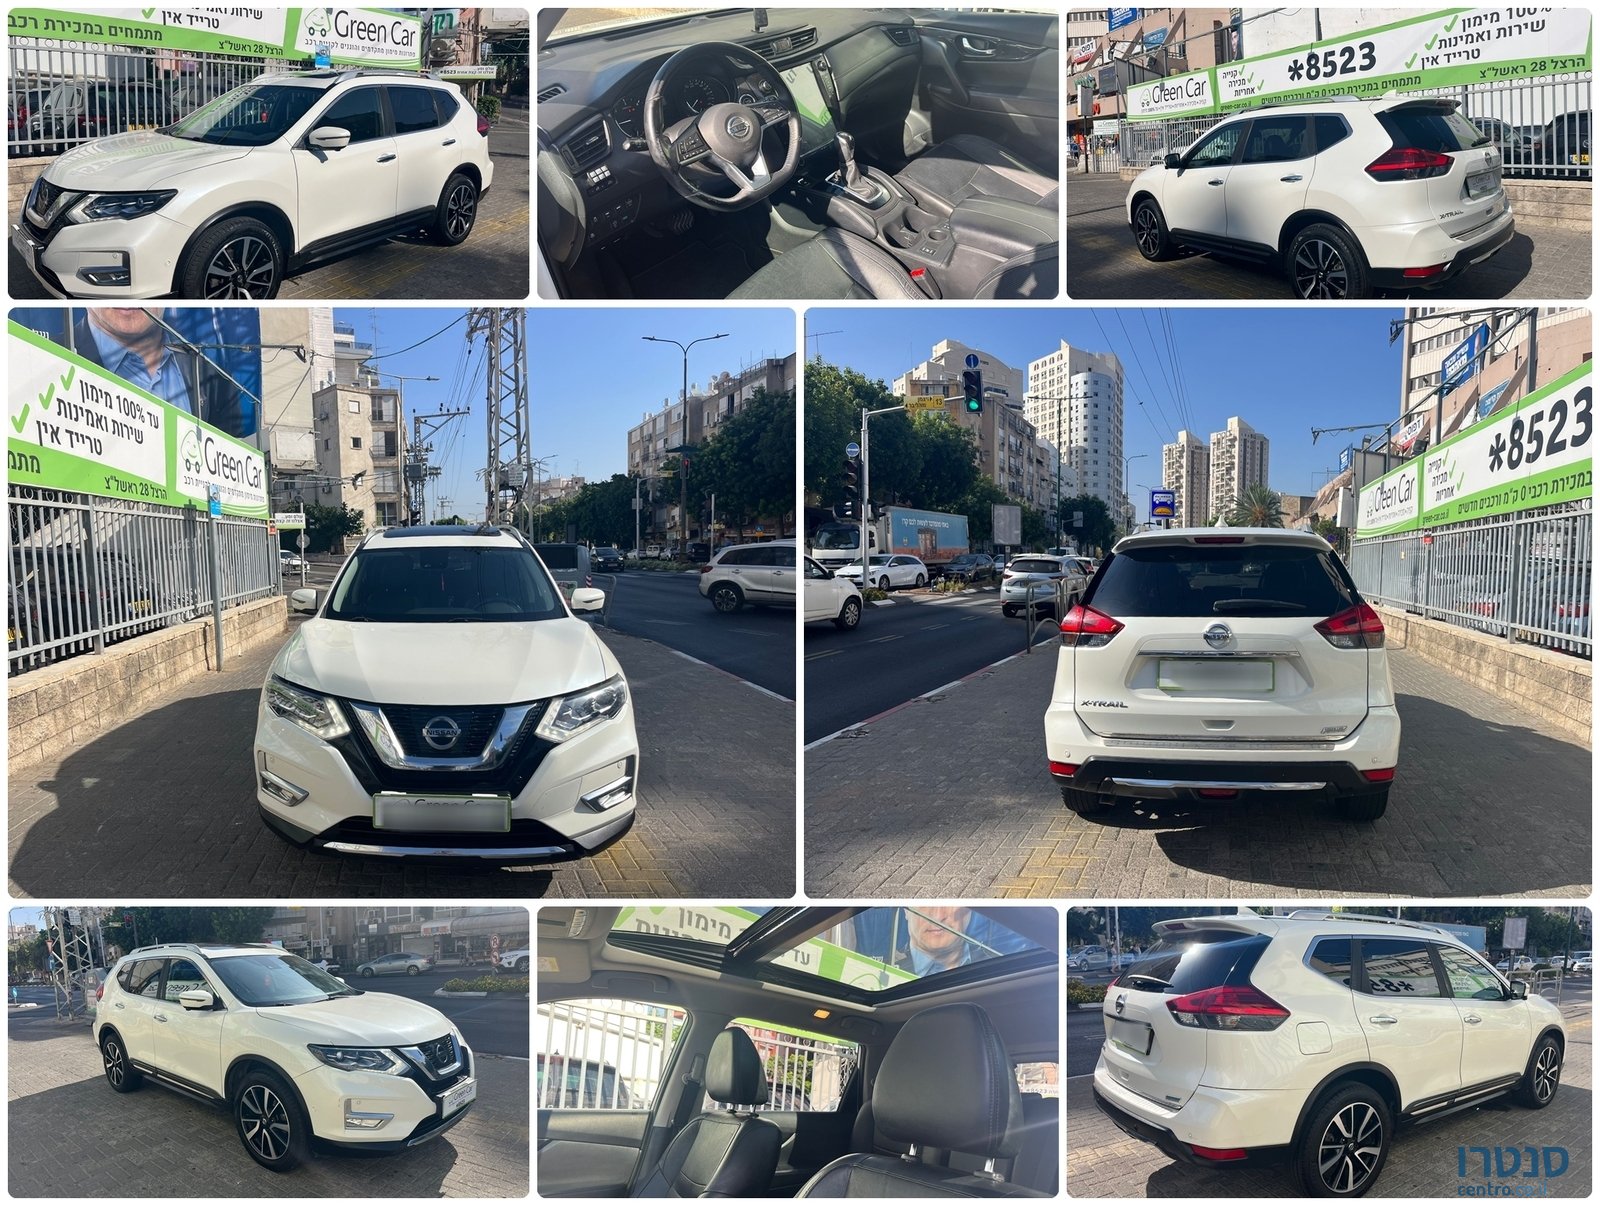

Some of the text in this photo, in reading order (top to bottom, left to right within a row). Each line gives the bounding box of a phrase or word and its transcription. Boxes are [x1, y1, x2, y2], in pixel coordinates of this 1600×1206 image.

[161, 10, 182, 26] אין
[186, 14, 220, 29] טרייד
[1461, 11, 1500, 32] מימון
[44, 18, 104, 36] במכירת
[108, 25, 163, 41] מתמחים
[334, 9, 416, 47] Green Car
[1438, 19, 1546, 50] שירות ואמינות
[253, 44, 263, 53] 28
[304, 38, 317, 46] רכב
[361, 45, 385, 54] מתקדמים
[265, 45, 284, 56] הרצל
[1421, 48, 1481, 70] טרייד אין
[1530, 60, 1547, 71] 28
[1551, 57, 1586, 69] הרצל
[1222, 69, 1238, 79] קנייה
[1381, 75, 1422, 89] מתמחים
[1152, 78, 1206, 104] Green Car
[1228, 78, 1246, 88] מכירה
[1347, 81, 1379, 94] במכירת
[1234, 87, 1256, 97] אחריות
[1220, 101, 1251, 112] green-car.co.il
[1439, 210, 1465, 220] X-TRAIL
[79, 379, 159, 429] עד 100% מימון
[56, 397, 144, 444] שירות ואמינות
[1407, 419, 1422, 437] דפוס
[36, 420, 103, 456] טרייד אין
[204, 436, 262, 489] Green Car
[183, 475, 195, 486] רכב
[1432, 471, 1448, 487] מכירה
[1551, 470, 1592, 498] במכירת
[139, 482, 149, 496] 28
[150, 486, 168, 500] הרצל
[1374, 473, 1415, 512] Green Car
[1435, 485, 1455, 502] אחריות
[1520, 485, 1526, 501] 0
[1528, 482, 1549, 499] רכבי
[1457, 500, 1478, 515] חדשים
[1479, 494, 1502, 510] ורכבים
[1081, 700, 1129, 709] X-TRAIL
[678, 907, 731, 940] מימון
[792, 948, 810, 966] עד
